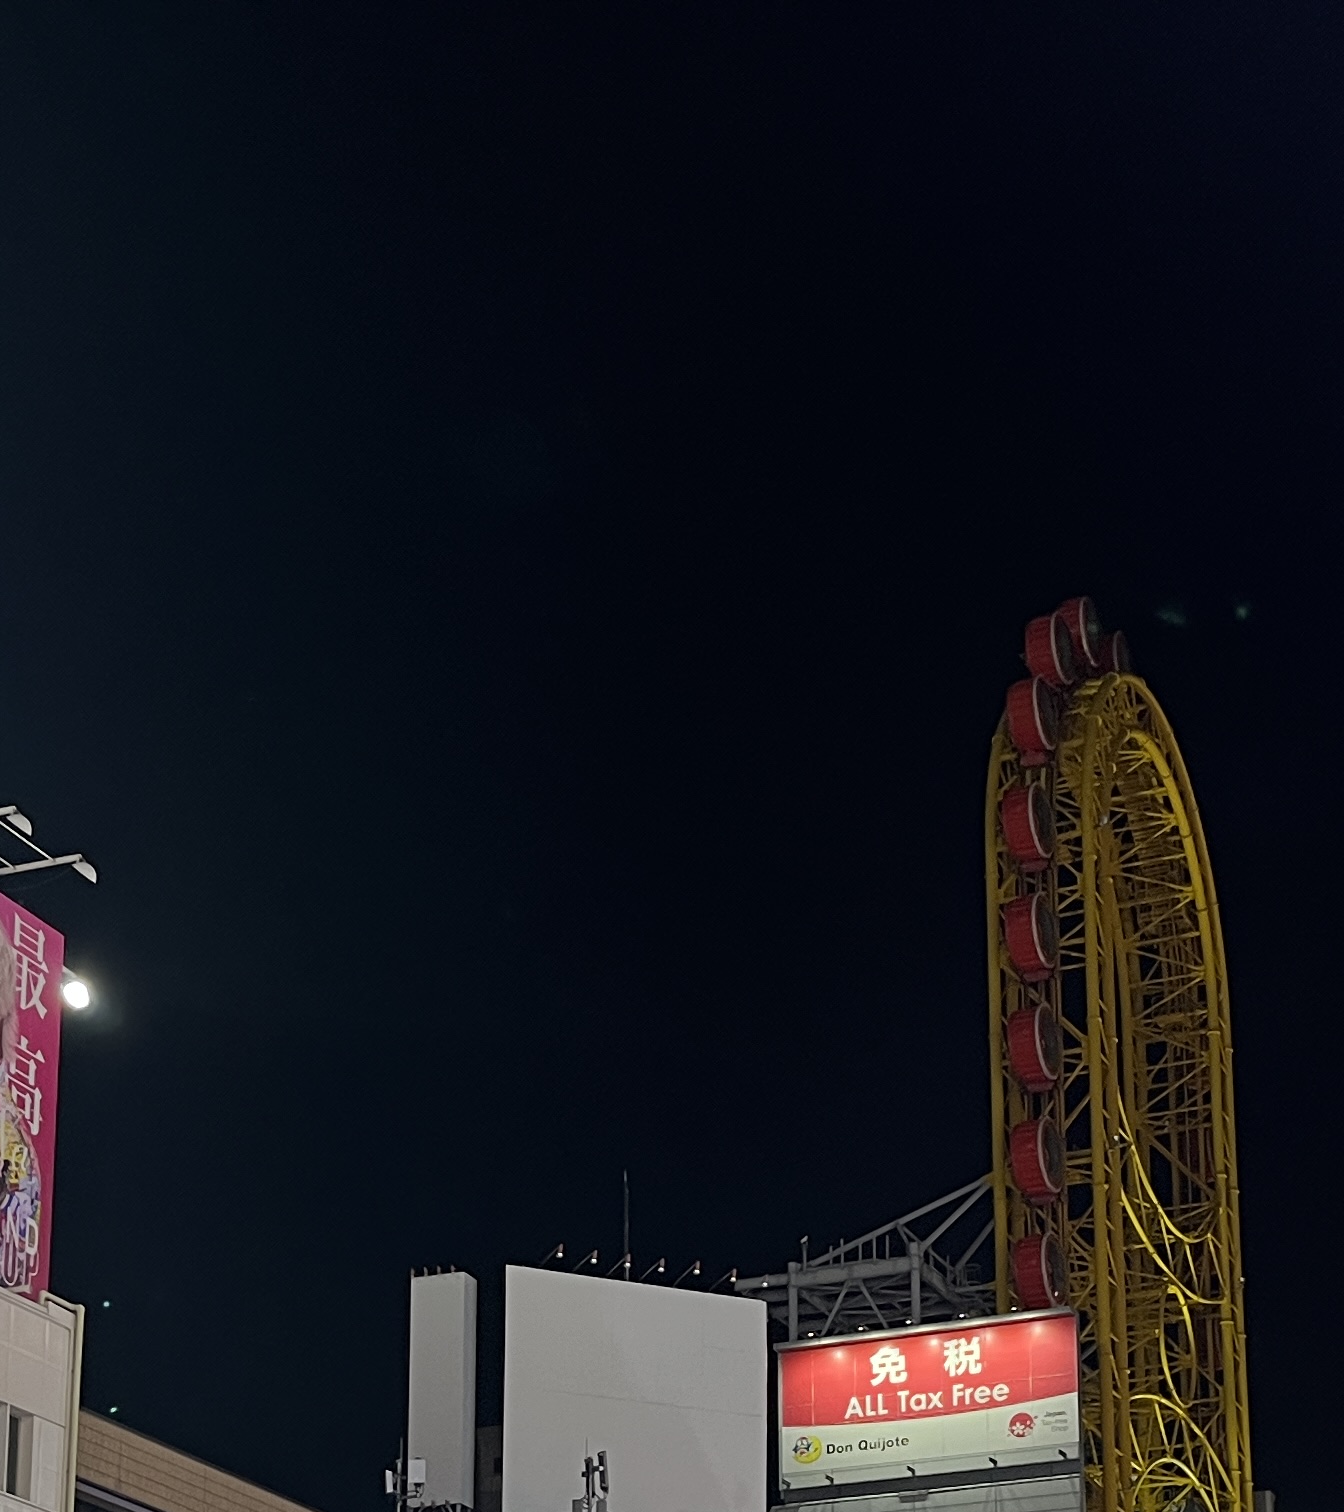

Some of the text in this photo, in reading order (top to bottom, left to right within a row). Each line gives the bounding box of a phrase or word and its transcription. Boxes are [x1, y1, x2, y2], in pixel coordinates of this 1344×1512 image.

[844, 1382, 1010, 1419] ALL Tax Free
[826, 1436, 910, 1455] Don Quijote
